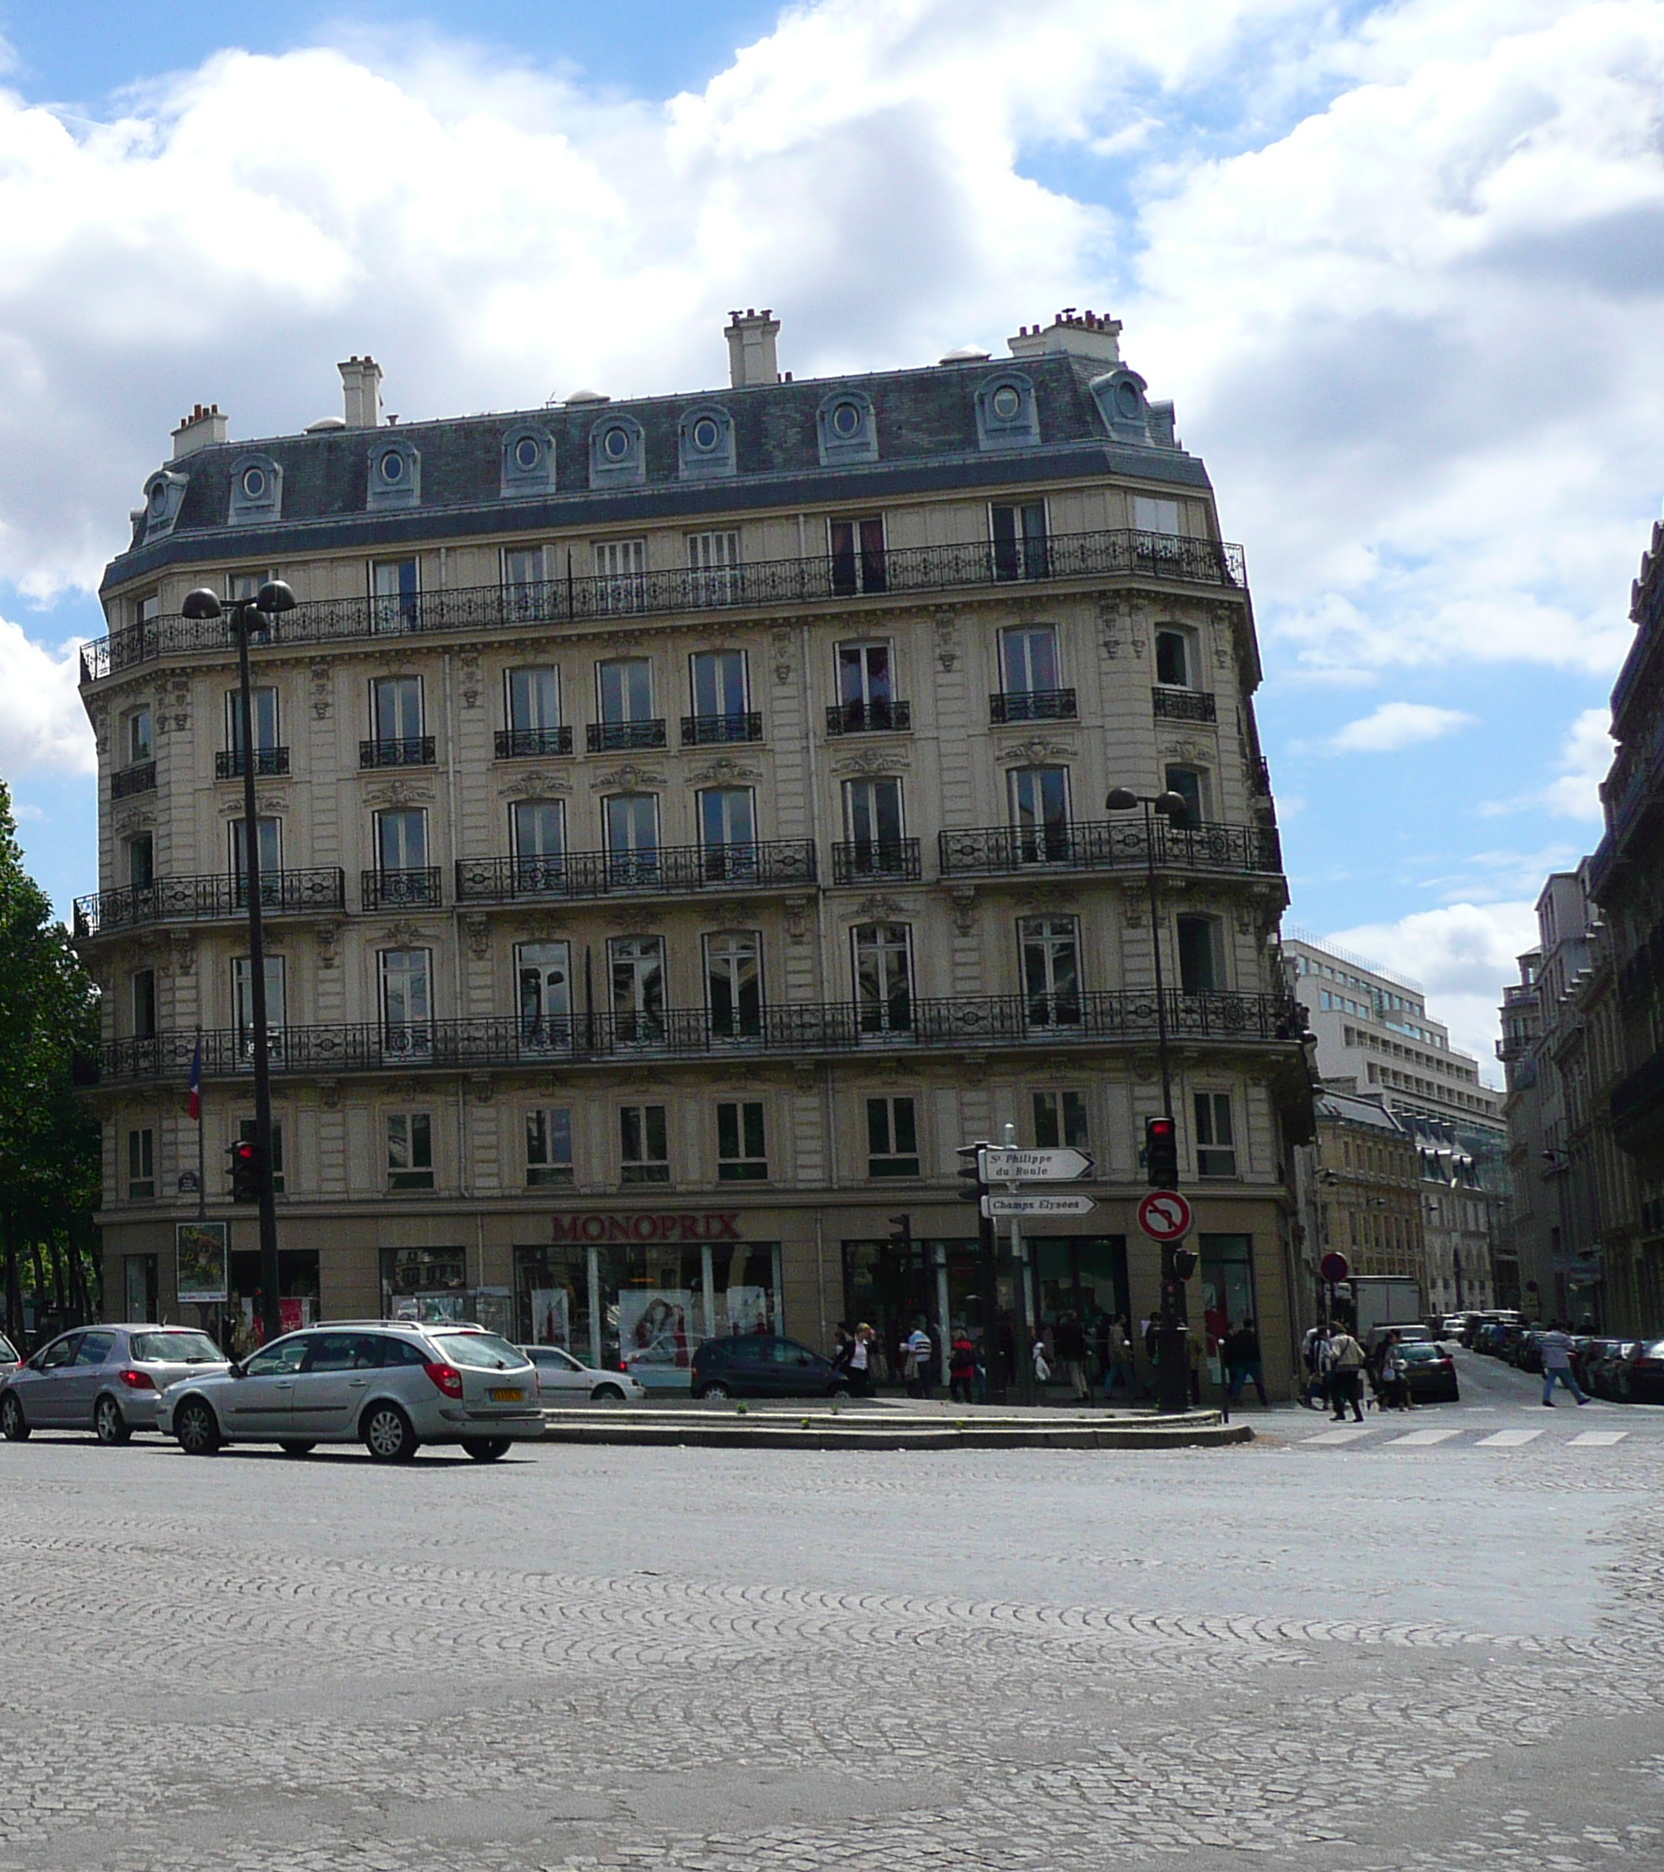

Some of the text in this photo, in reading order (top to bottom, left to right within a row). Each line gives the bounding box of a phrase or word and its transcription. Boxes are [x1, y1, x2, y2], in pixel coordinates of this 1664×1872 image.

[1005, 1153, 1053, 1165] Philippe
[995, 1166, 1049, 1176] du Roule
[992, 1200, 1035, 1211] Champs
[551, 1212, 742, 1242] MONOPRIX
